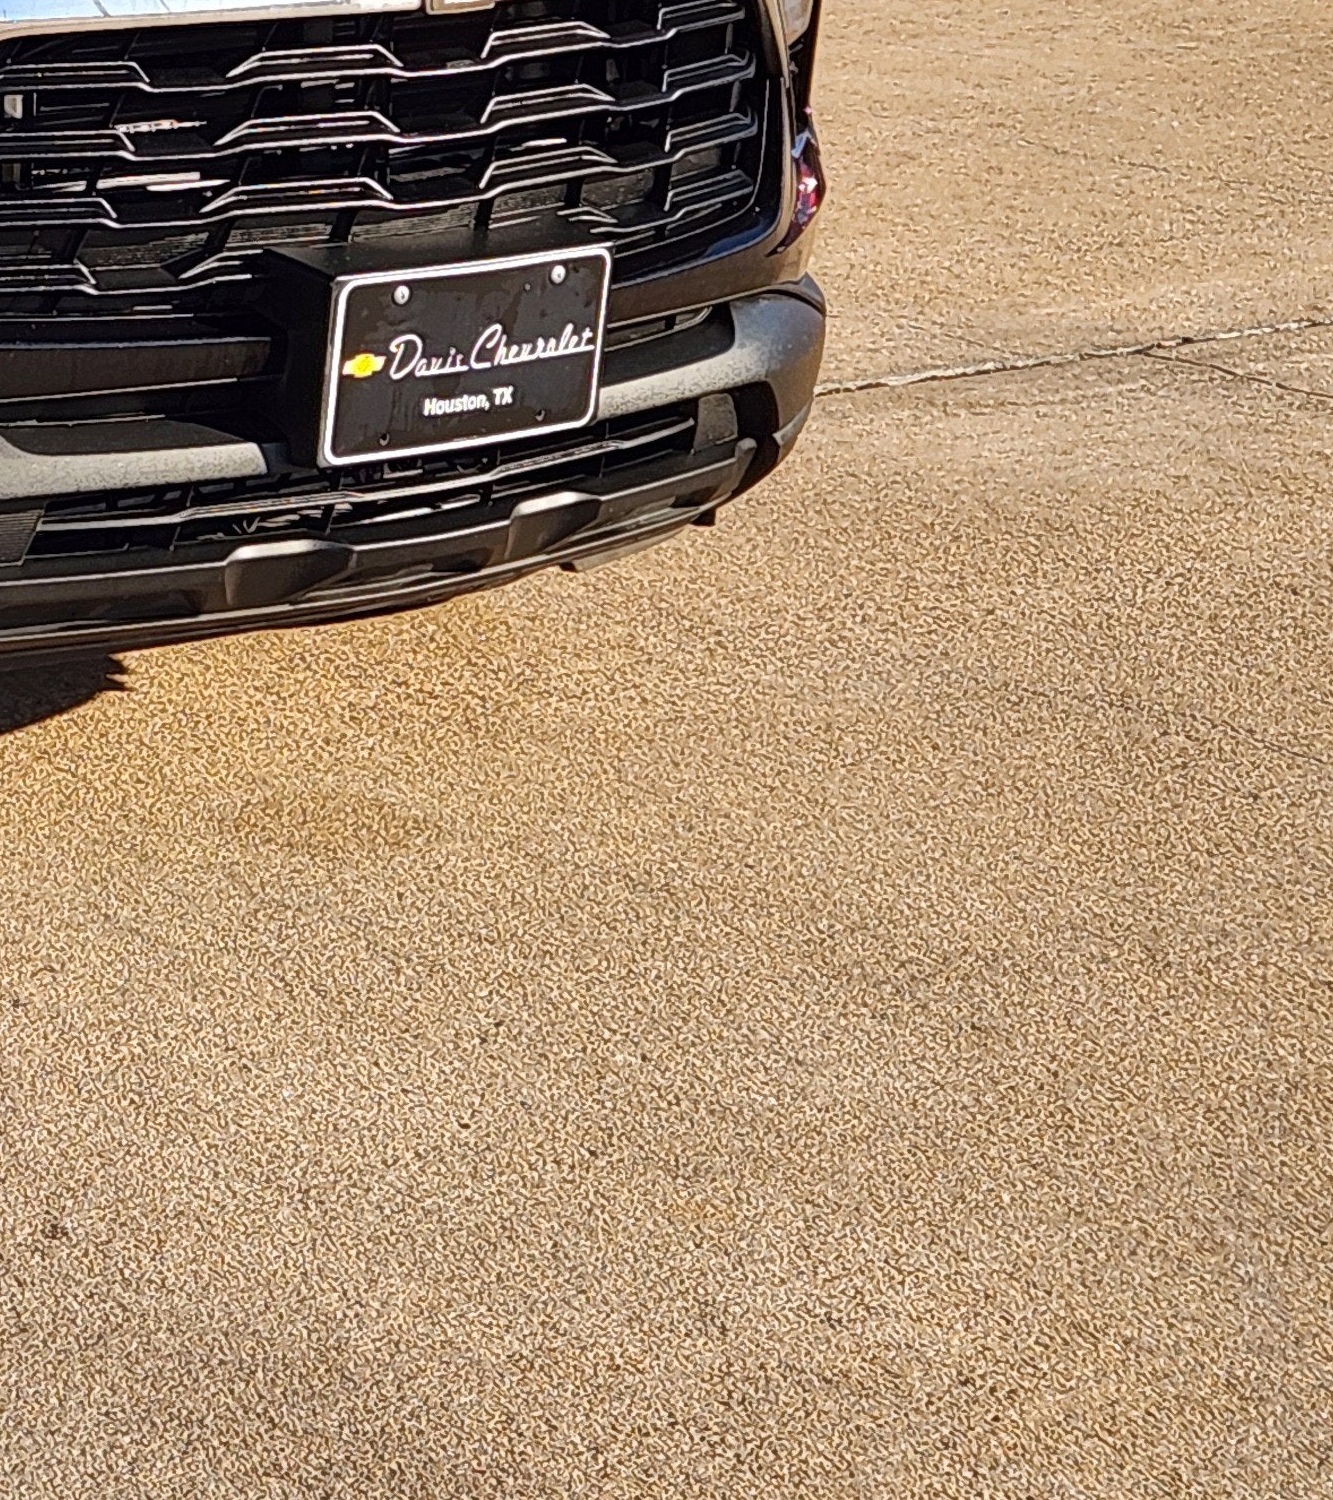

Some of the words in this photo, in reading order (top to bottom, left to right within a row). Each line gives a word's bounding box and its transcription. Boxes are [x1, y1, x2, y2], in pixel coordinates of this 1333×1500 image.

[388, 333, 469, 380] Davis
[470, 323, 595, 371] Chevrolet
[423, 393, 490, 417] Houston,
[493, 386, 514, 406] TX
